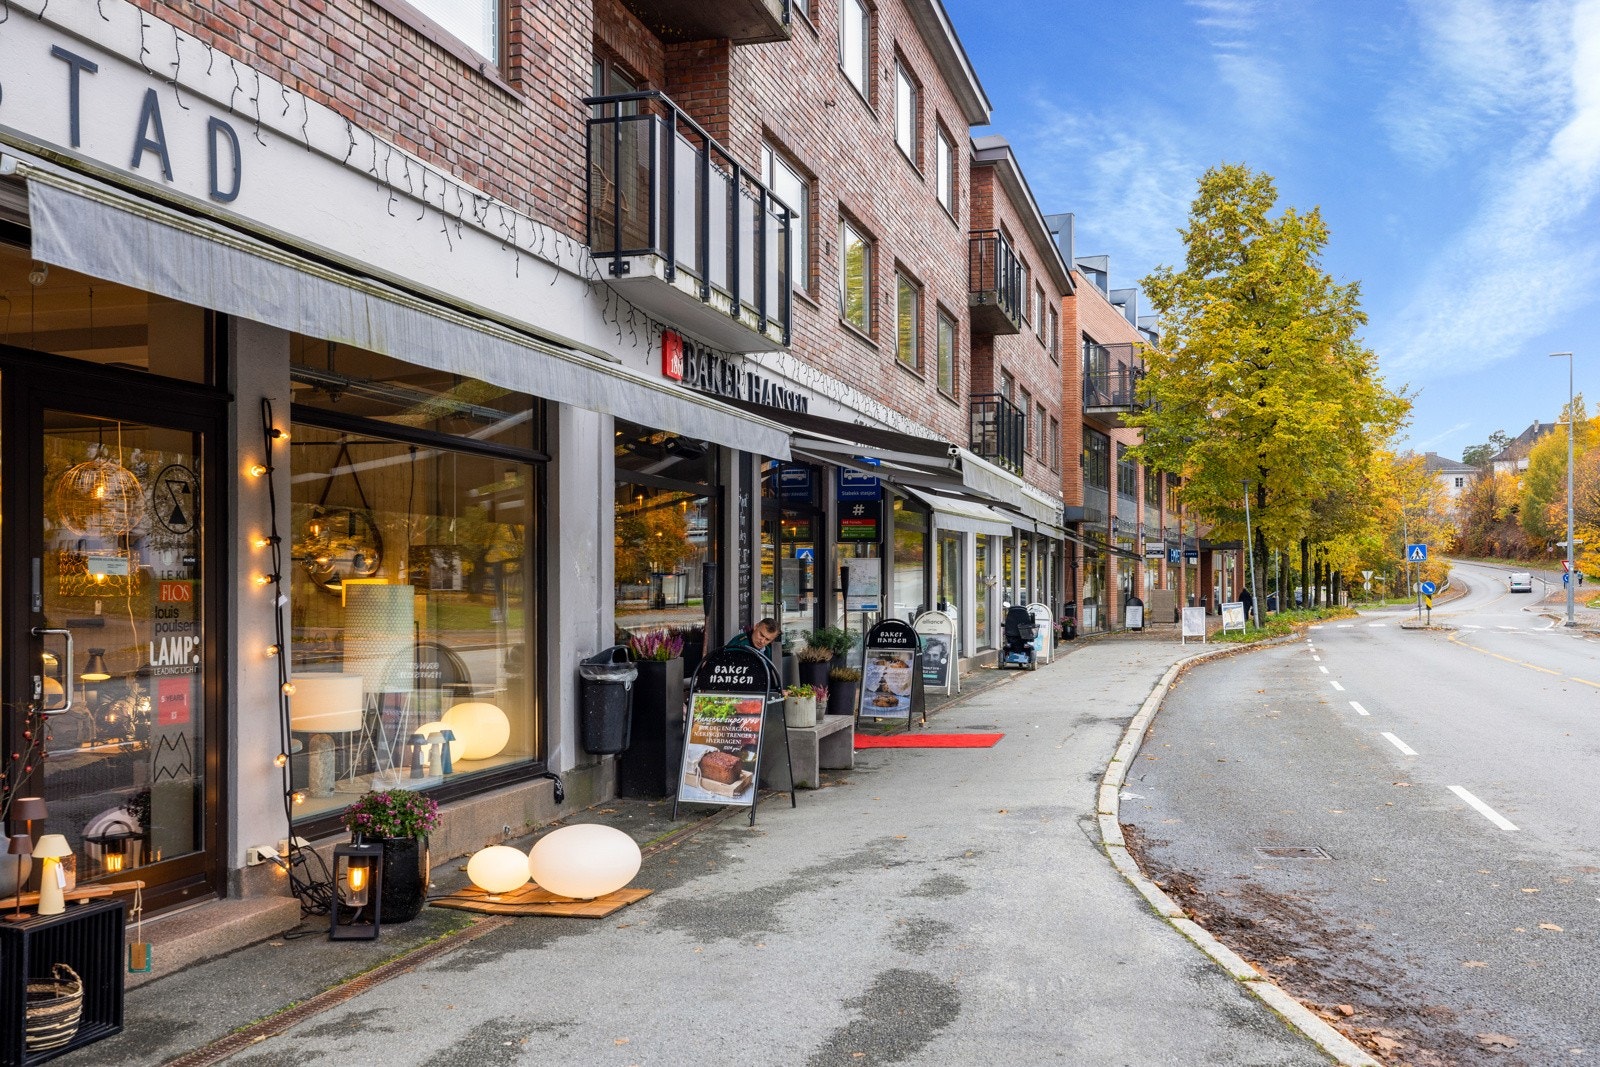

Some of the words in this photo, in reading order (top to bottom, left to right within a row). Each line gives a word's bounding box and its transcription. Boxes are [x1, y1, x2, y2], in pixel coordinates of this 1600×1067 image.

[0, 44, 242, 204] TAD
[683, 340, 742, 400] BAKER
[746, 372, 809, 414] HANSEN
[162, 584, 190, 602] FLOS
[155, 605, 179, 620] louis
[153, 667, 181, 677] LEADING
